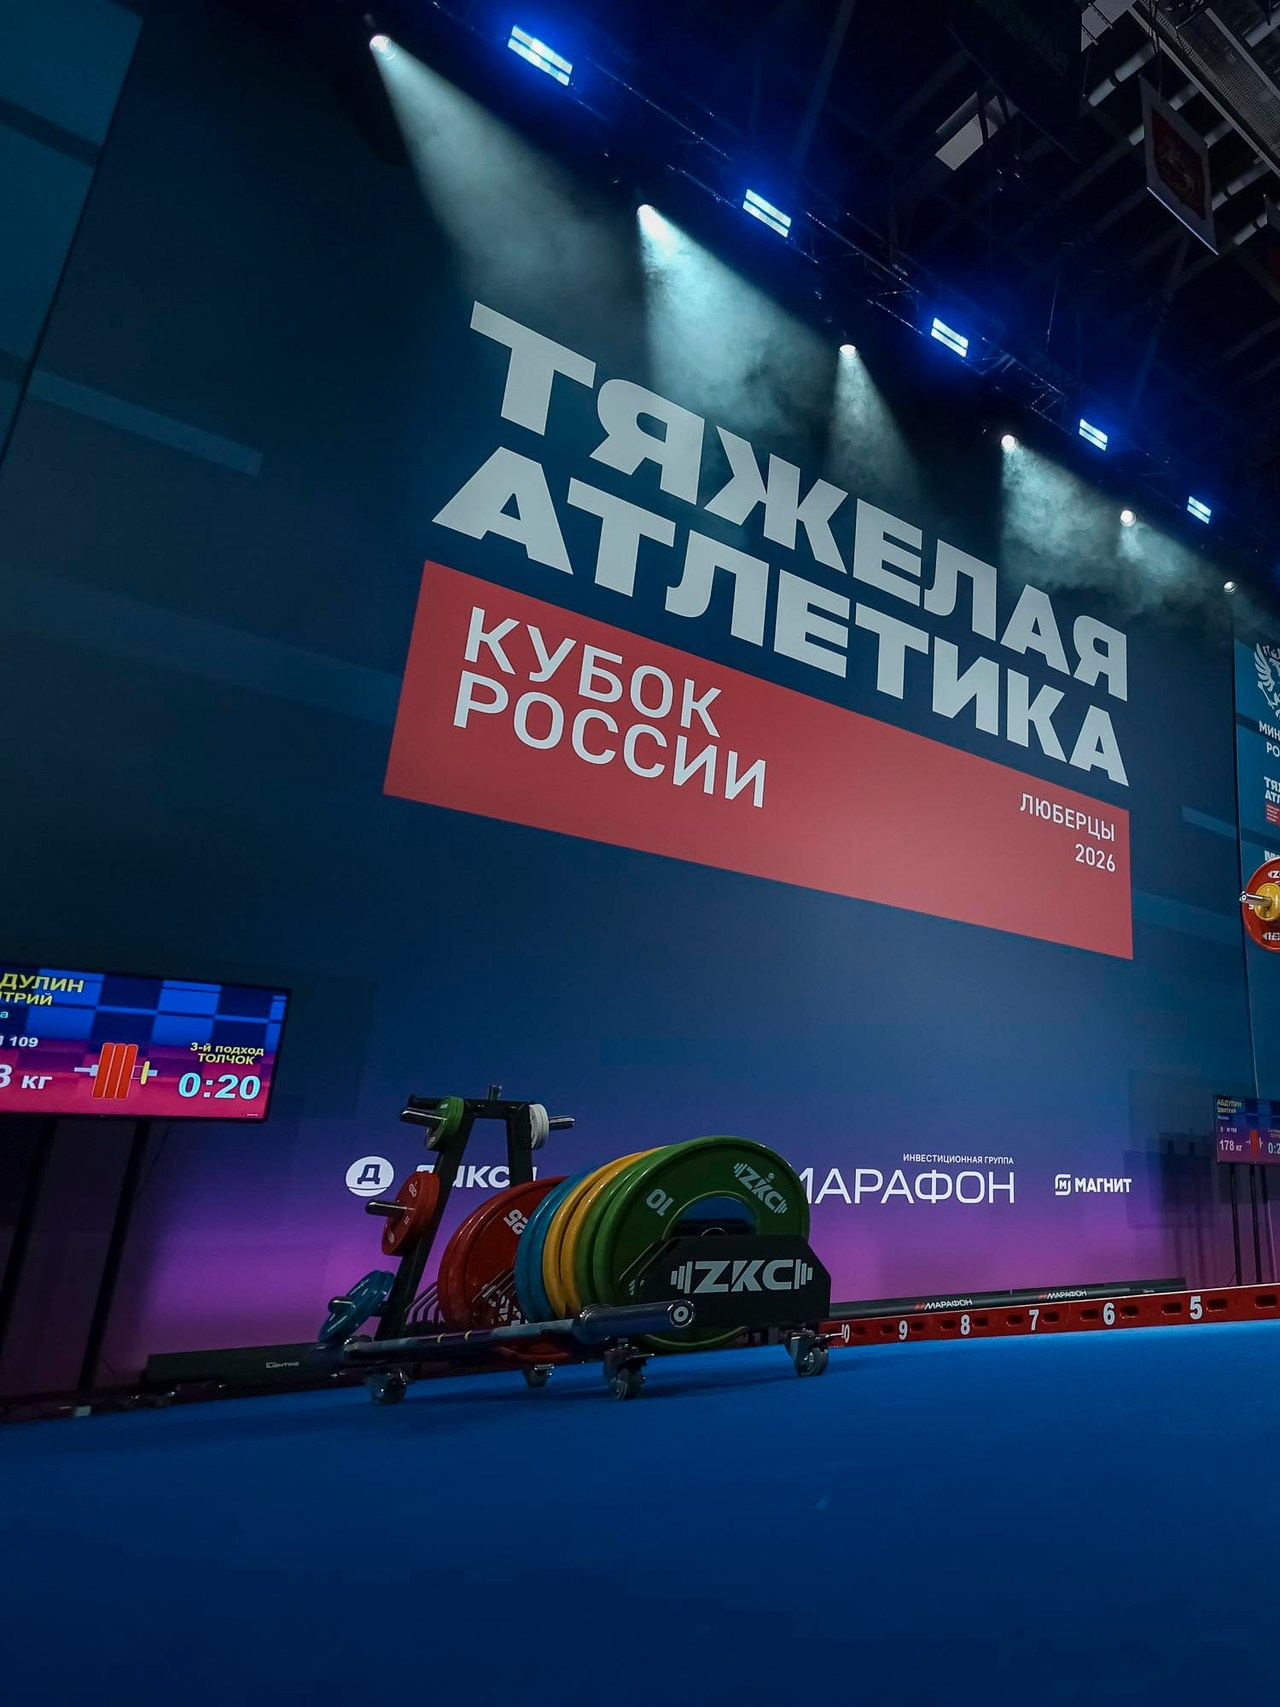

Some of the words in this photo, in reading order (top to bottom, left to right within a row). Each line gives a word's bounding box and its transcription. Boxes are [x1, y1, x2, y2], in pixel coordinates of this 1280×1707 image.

[469, 300, 1128, 702] ТЯЖЕЛАЯ
[432, 446, 1129, 787] АТЛЕТИКА
[462, 606, 723, 737] КУБОК
[453, 670, 767, 807] РОССИИ
[1019, 792, 1117, 842] ЛЮБЕРЦЫ
[1074, 843, 1117, 873] 2026
[9, 1036, 39, 1048] 109
[190, 1042, 212, 1053] 3-й
[215, 1044, 265, 1057] подход
[197, 1053, 256, 1066] ТОЛЧОК
[178, 1072, 261, 1100] 0:20
[1220, 1139, 1235, 1151] 178
[903, 1153, 983, 1164] ИНВЕСТИЦИОННАЯ
[984, 1155, 1014, 1165] ГРУППА
[737, 1166, 785, 1212] ZKC
[1074, 1178, 1133, 1193] МАГНИТ
[646, 1188, 674, 1217] 10
[693, 1259, 794, 1294] ZKC
[924, 1298, 973, 1311] МАРАФОН
[1047, 1290, 1087, 1300] МАРАФОН
[1103, 1302, 1115, 1325] 6
[1189, 1296, 1203, 1320] 5
[898, 1320, 908, 1341] 9
[960, 1314, 971, 1335] 8
[1029, 1309, 1039, 1331] 7
